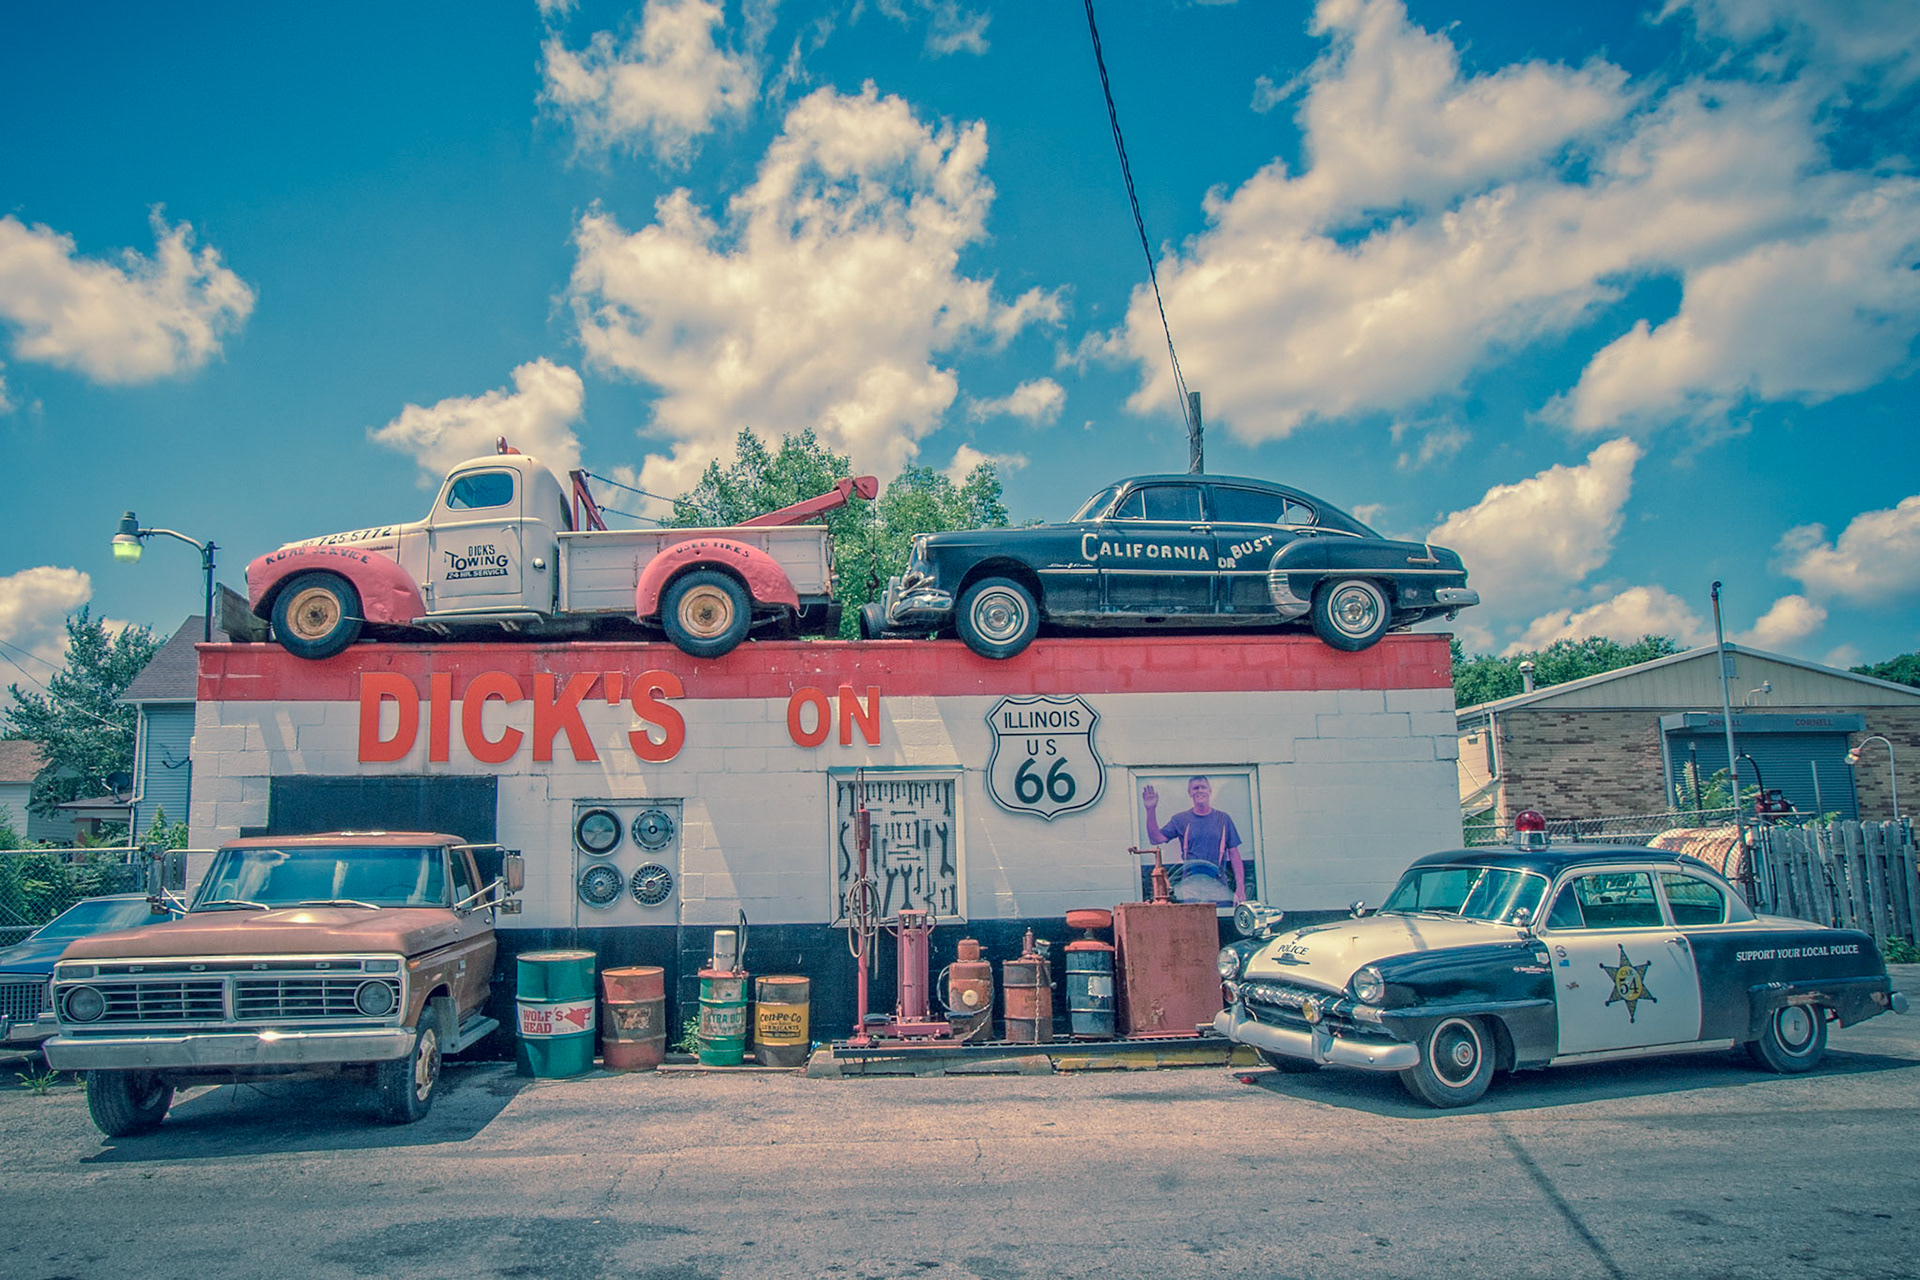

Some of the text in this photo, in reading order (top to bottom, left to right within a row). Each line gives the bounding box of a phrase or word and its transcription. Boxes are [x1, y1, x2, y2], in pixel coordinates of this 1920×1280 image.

[317, 533, 348, 547] 725
[350, 527, 393, 542] 5772
[468, 544, 496, 557] DICK'S
[1081, 533, 1210, 561] CALIFORNIA
[1230, 535, 1273, 560] BUST
[444, 551, 509, 570] TOWING
[1218, 556, 1236, 569] OR
[473, 569, 506, 577] SERVICE
[358, 670, 881, 763] DICK'S ON
[1004, 711, 1080, 729] ILLINOIS
[1794, 718, 1832, 727] CORNELL
[1015, 756, 1076, 804] 66
[1278, 944, 1309, 955] POLICE
[1736, 944, 1859, 961] SUPPORT YOUR LOCAL POLICE
[1619, 977, 1639, 994] 54
[523, 1007, 564, 1022] WOLF'S
[524, 1022, 552, 1034] HEAD
